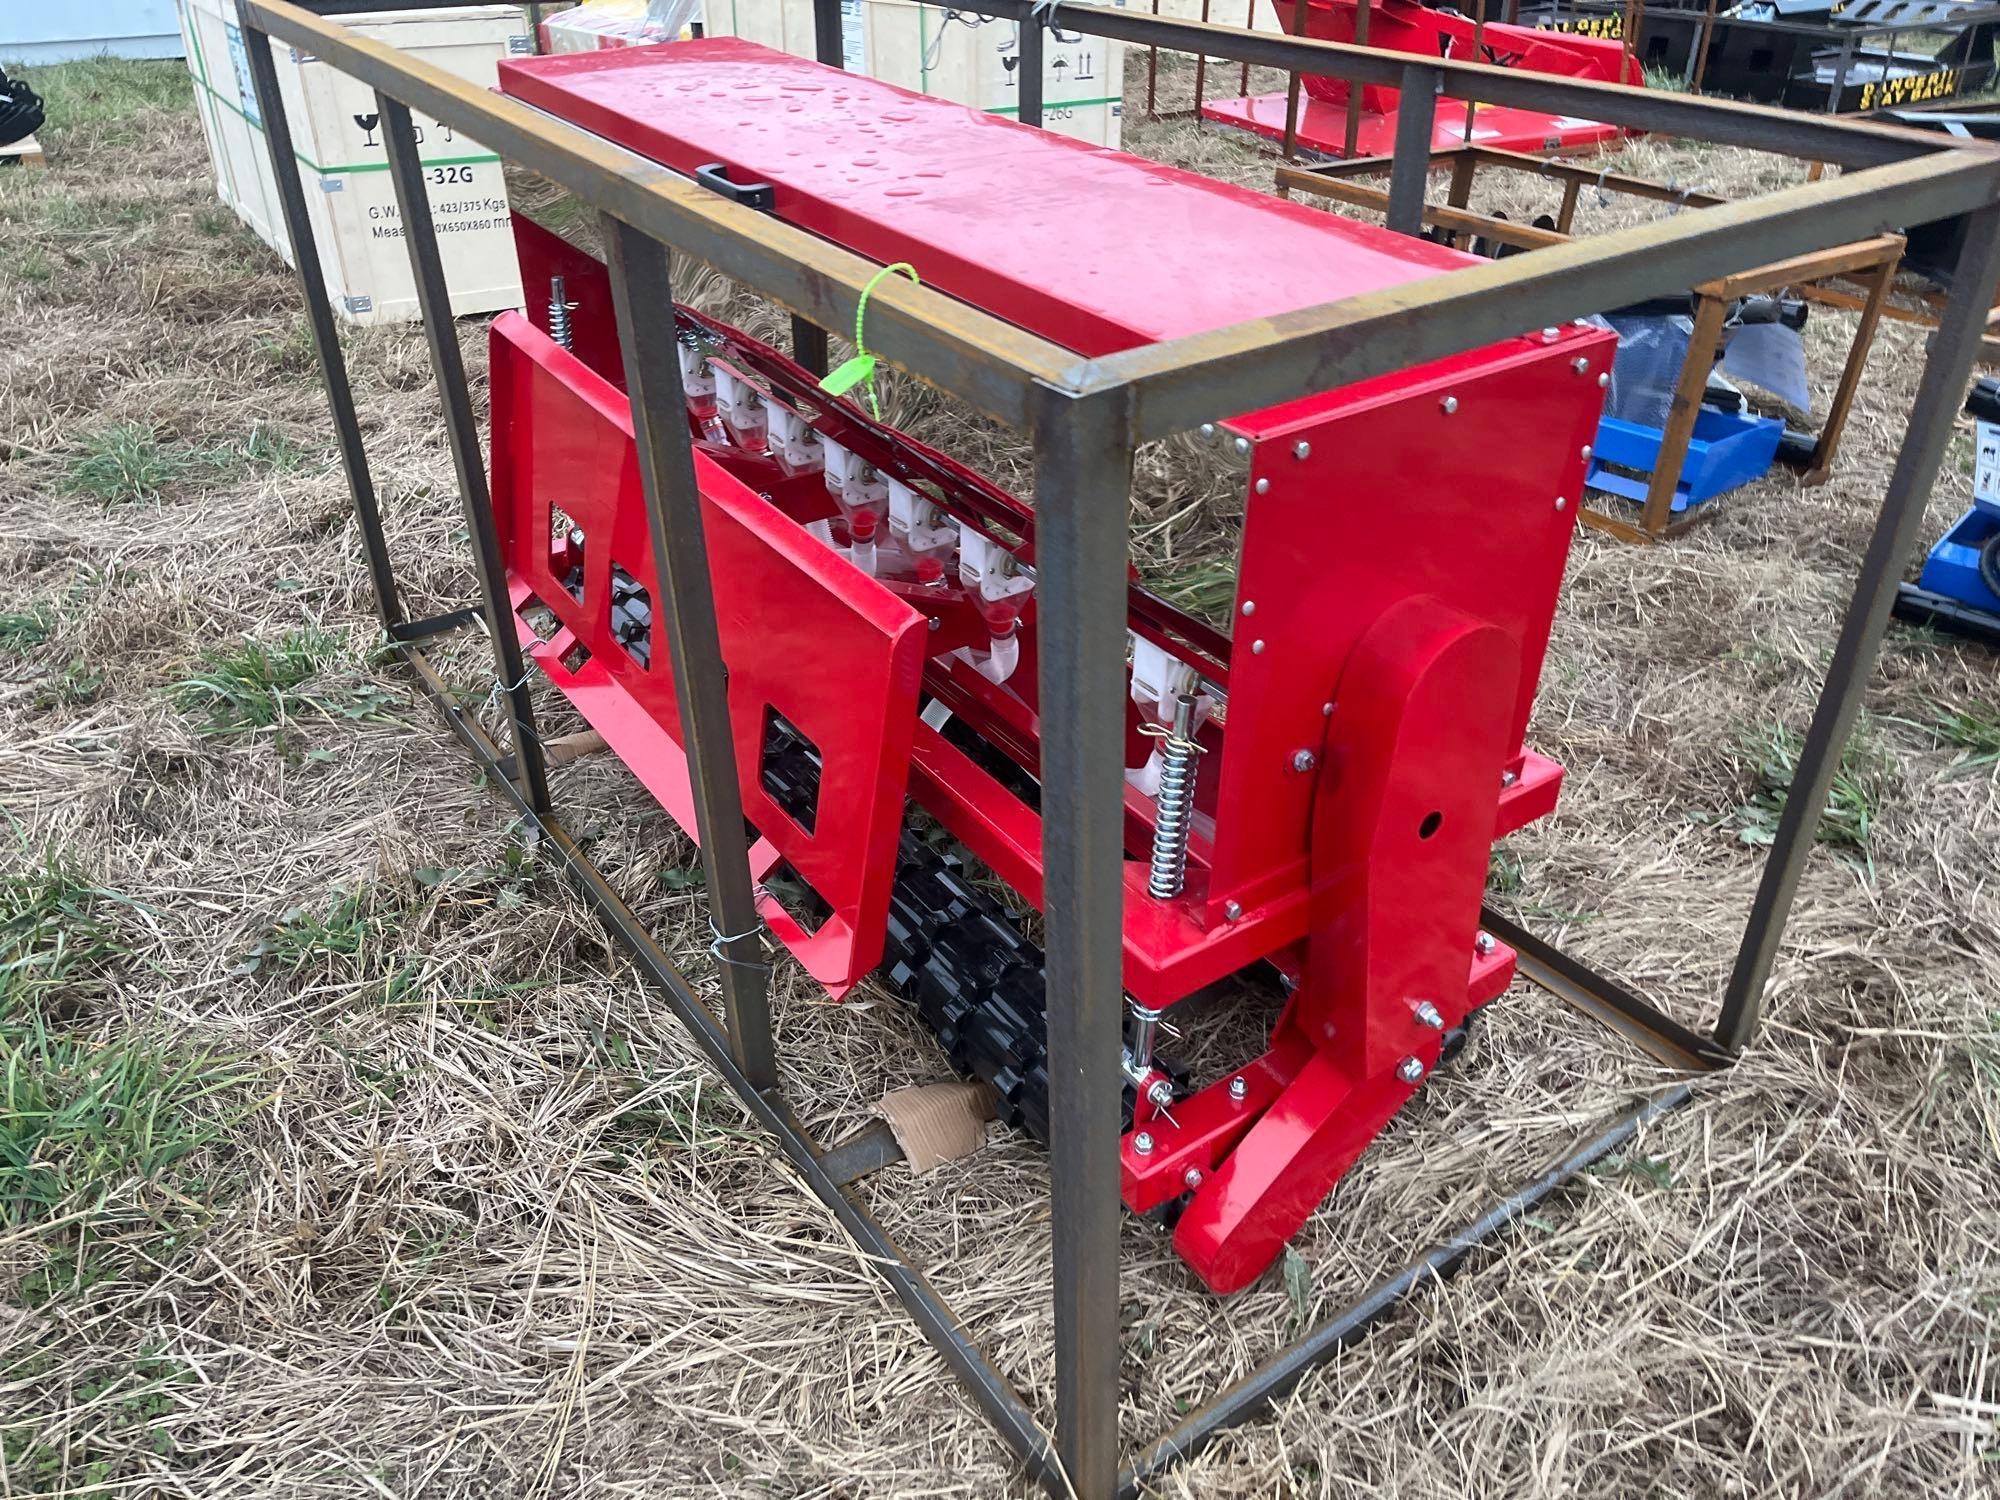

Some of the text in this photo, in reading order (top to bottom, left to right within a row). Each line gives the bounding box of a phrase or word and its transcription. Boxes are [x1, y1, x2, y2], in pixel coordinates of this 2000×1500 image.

[1587, 28, 1625, 40] BAC
[1860, 88, 1906, 110] SAY
[426, 166, 473, 184] -32G
[440, 201, 481, 214] 423/375
[483, 198, 506, 212] Kgs
[372, 226, 406, 238] Meas
[434, 219, 491, 233] 0X650X860
